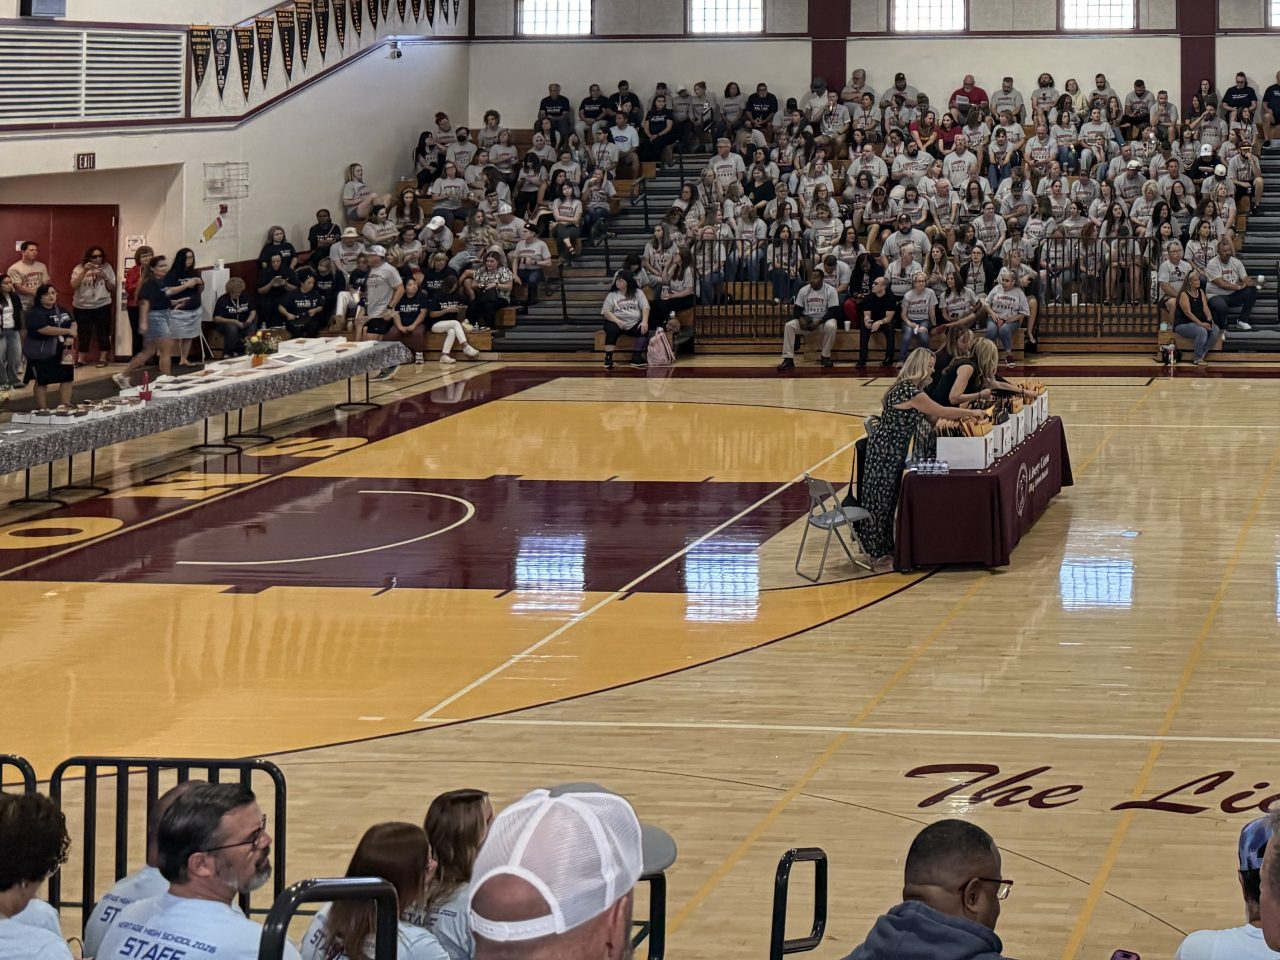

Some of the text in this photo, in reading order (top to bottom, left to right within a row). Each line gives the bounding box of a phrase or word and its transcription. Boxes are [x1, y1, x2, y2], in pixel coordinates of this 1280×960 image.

[79, 154, 94, 169] EXIT
[904, 763, 1084, 809] The
[119, 936, 187, 960] STAFF
[161, 932, 192, 946] SCHOOL
